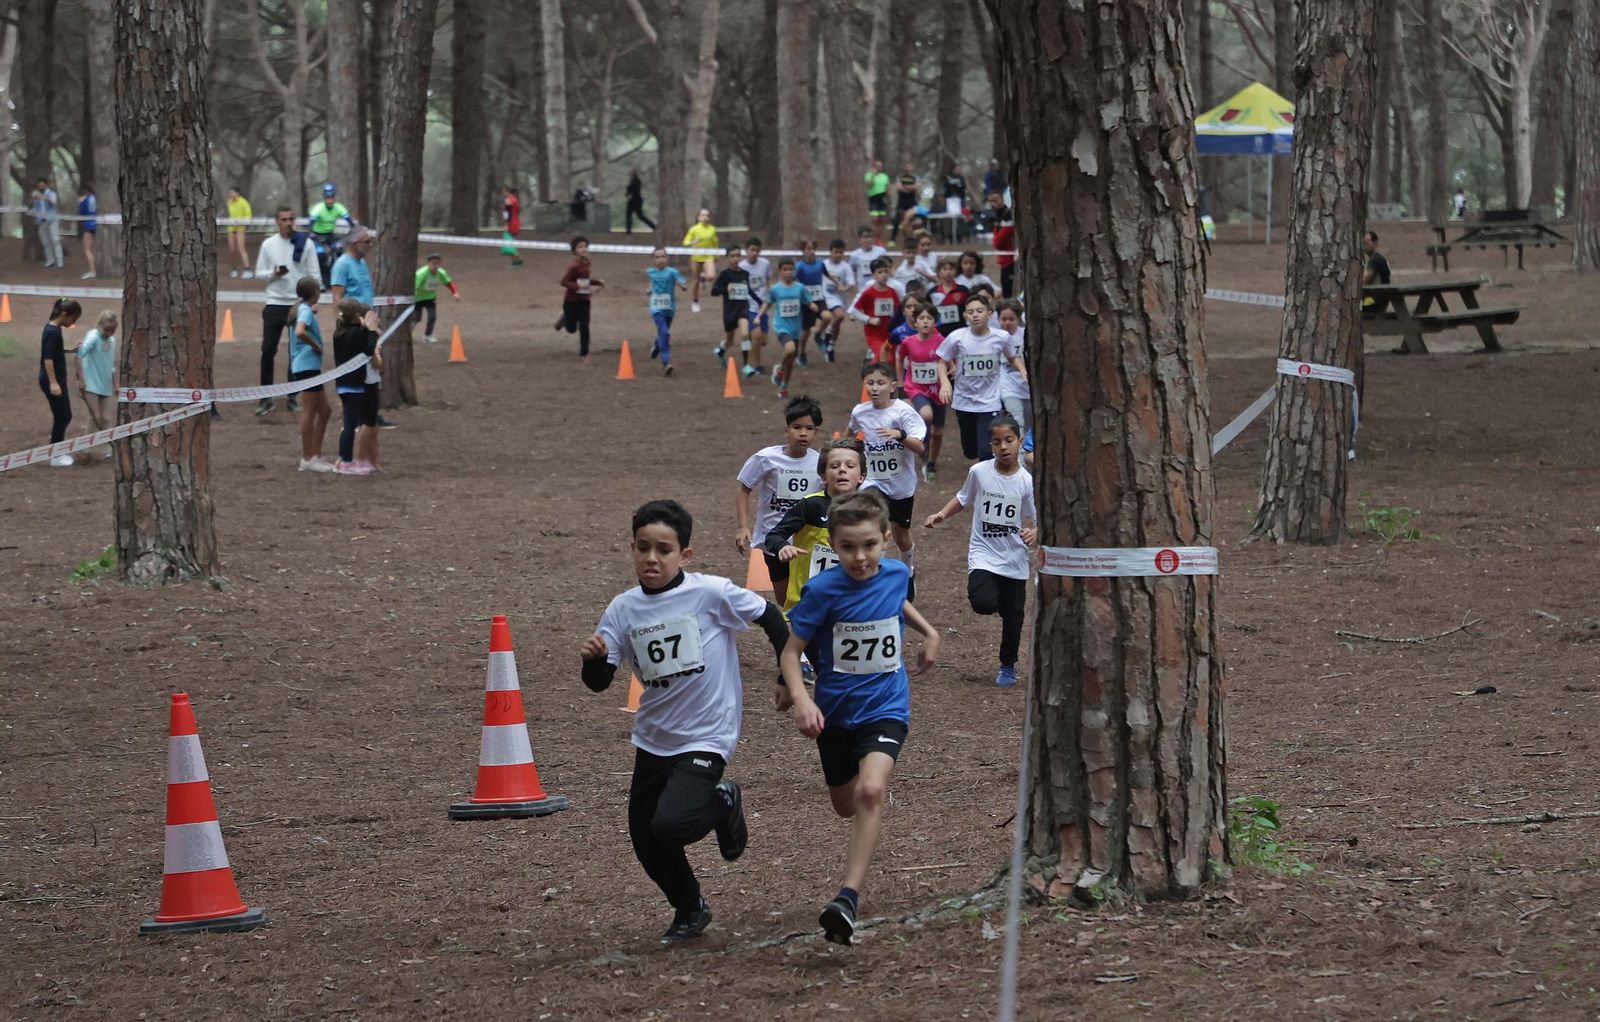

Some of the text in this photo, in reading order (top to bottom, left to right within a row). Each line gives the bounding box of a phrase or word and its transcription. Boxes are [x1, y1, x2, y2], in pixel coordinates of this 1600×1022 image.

[968, 359, 994, 371] 100
[914, 368, 936, 379] 179
[870, 458, 898, 473] 106
[788, 477, 809, 492] 69
[983, 500, 1016, 518] 116
[638, 623, 666, 636] CROSS
[844, 624, 876, 632] CROSS
[647, 634, 682, 664] 67
[840, 635, 896, 661] 278
